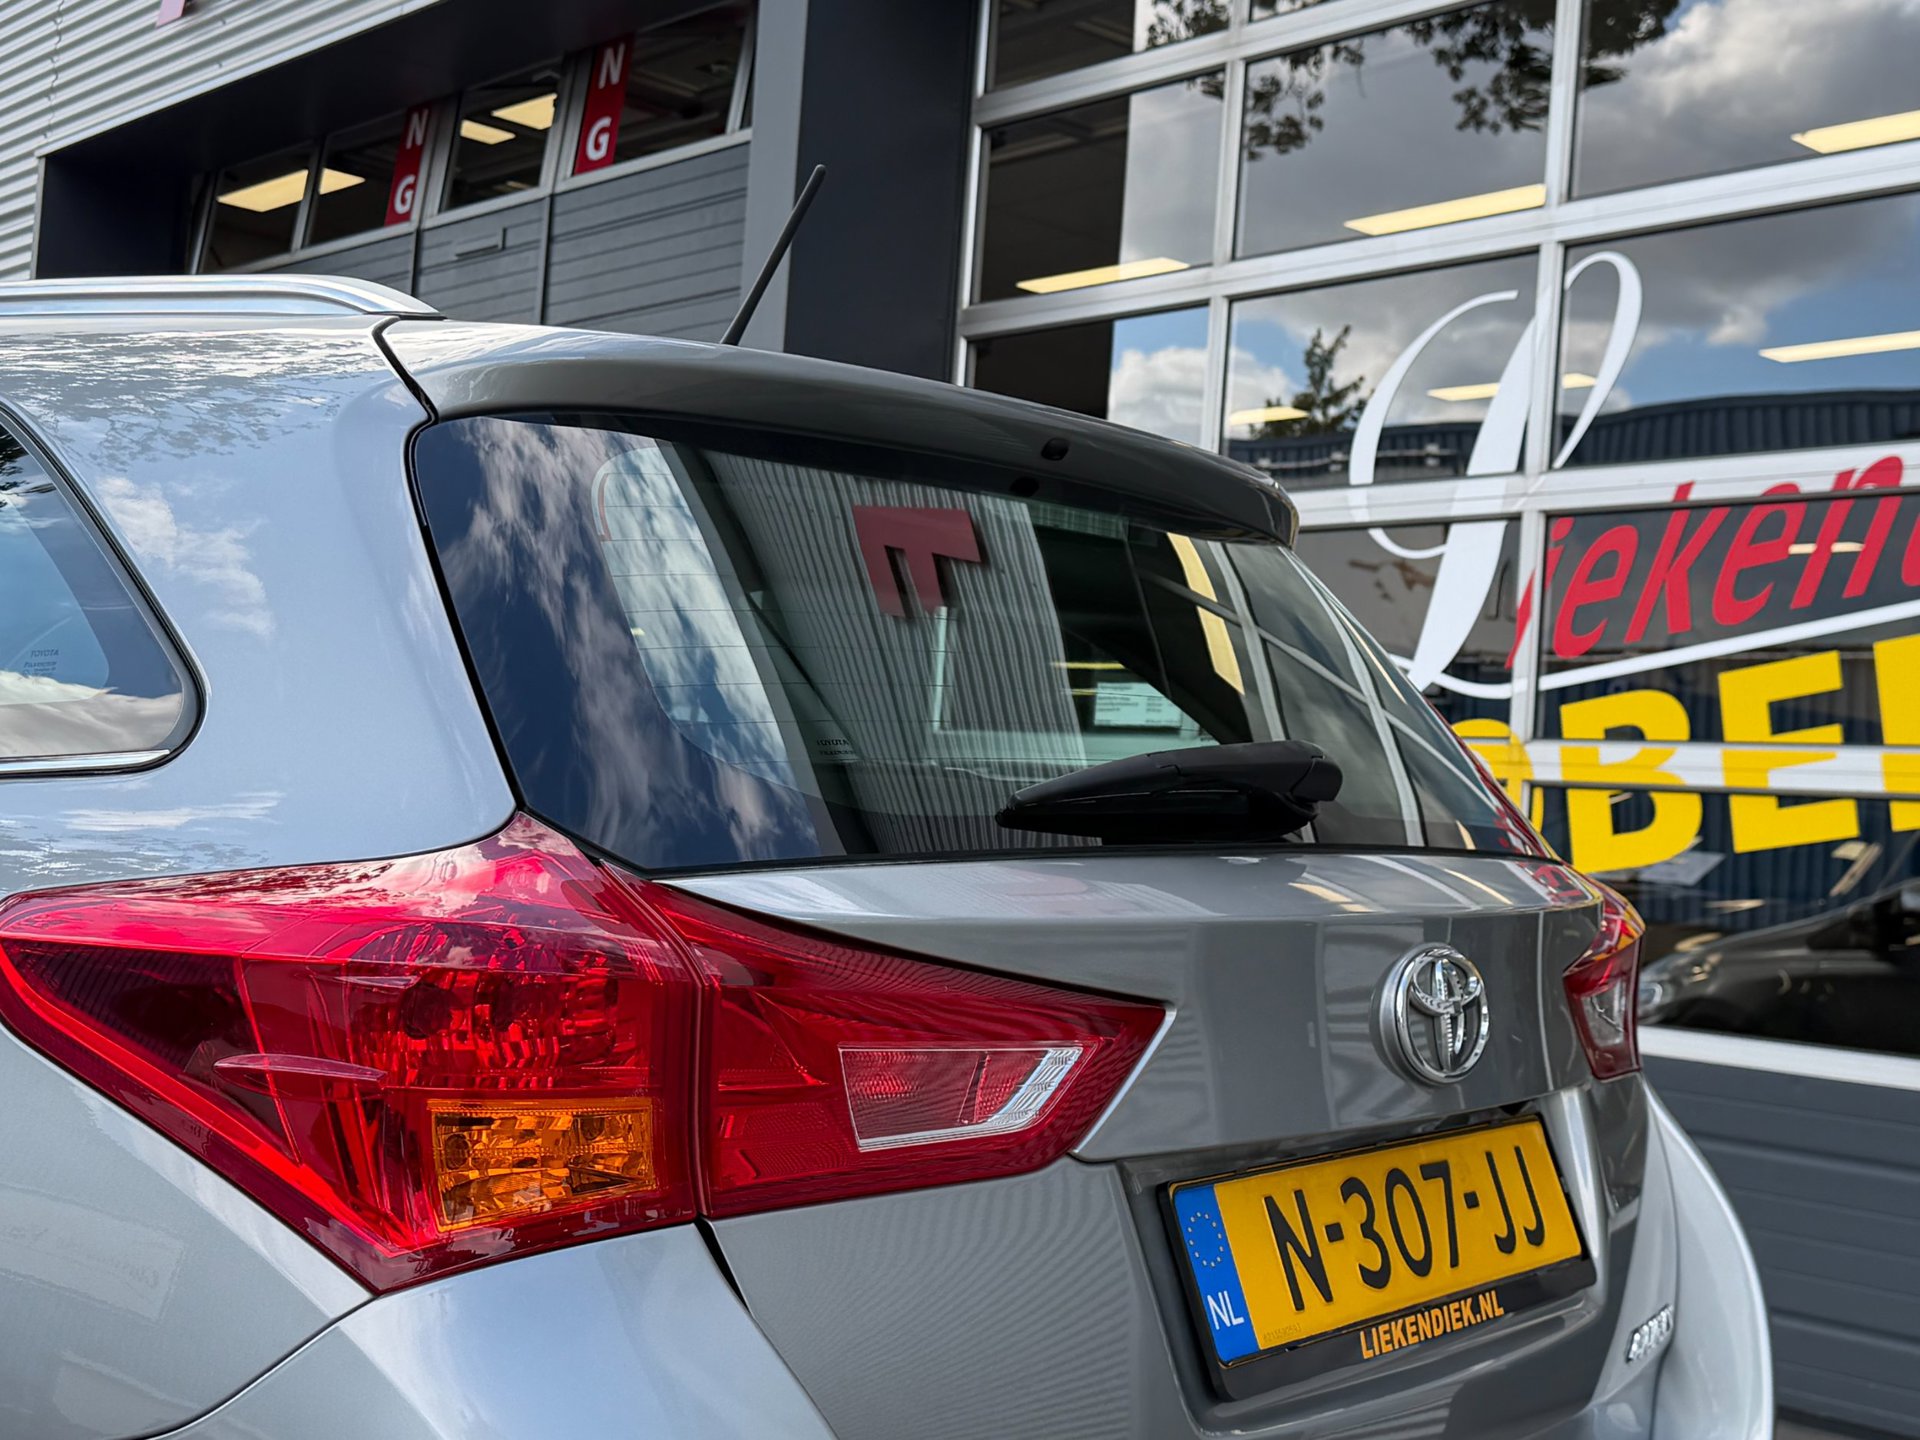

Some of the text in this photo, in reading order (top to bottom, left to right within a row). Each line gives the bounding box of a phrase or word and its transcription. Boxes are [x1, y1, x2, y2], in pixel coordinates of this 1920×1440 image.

[1349, 251, 1920, 698] Lieken
[1263, 1145, 1545, 1312] N-307-JJ
[1206, 1291, 1245, 1331] NL
[1359, 1290, 1504, 1360] LIEKENDIEK.NL
